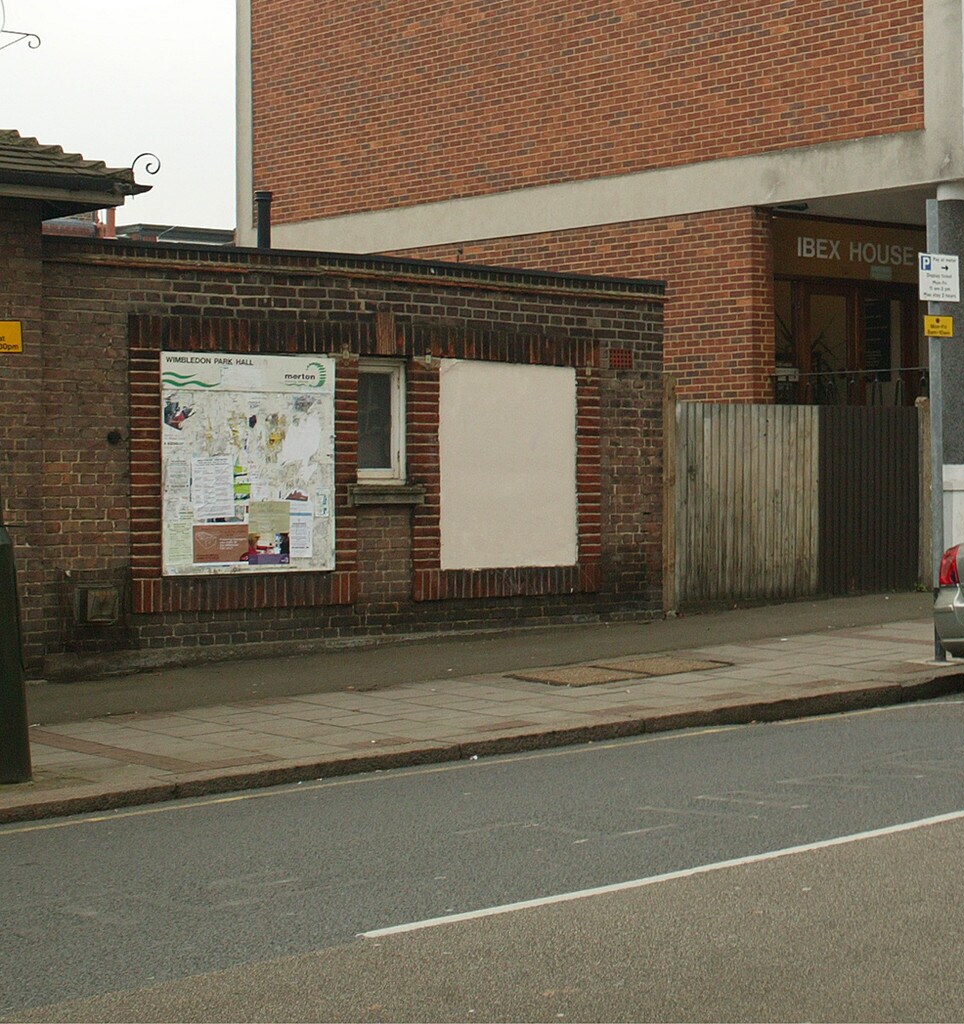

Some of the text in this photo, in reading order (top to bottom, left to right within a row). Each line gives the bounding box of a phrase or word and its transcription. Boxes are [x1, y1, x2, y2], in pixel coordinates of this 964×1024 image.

[797, 236, 914, 266] IBEX HOUSE
[922, 256, 931, 270] P
[166, 356, 212, 365] WIMBLEDON
[213, 357, 233, 366] PARK
